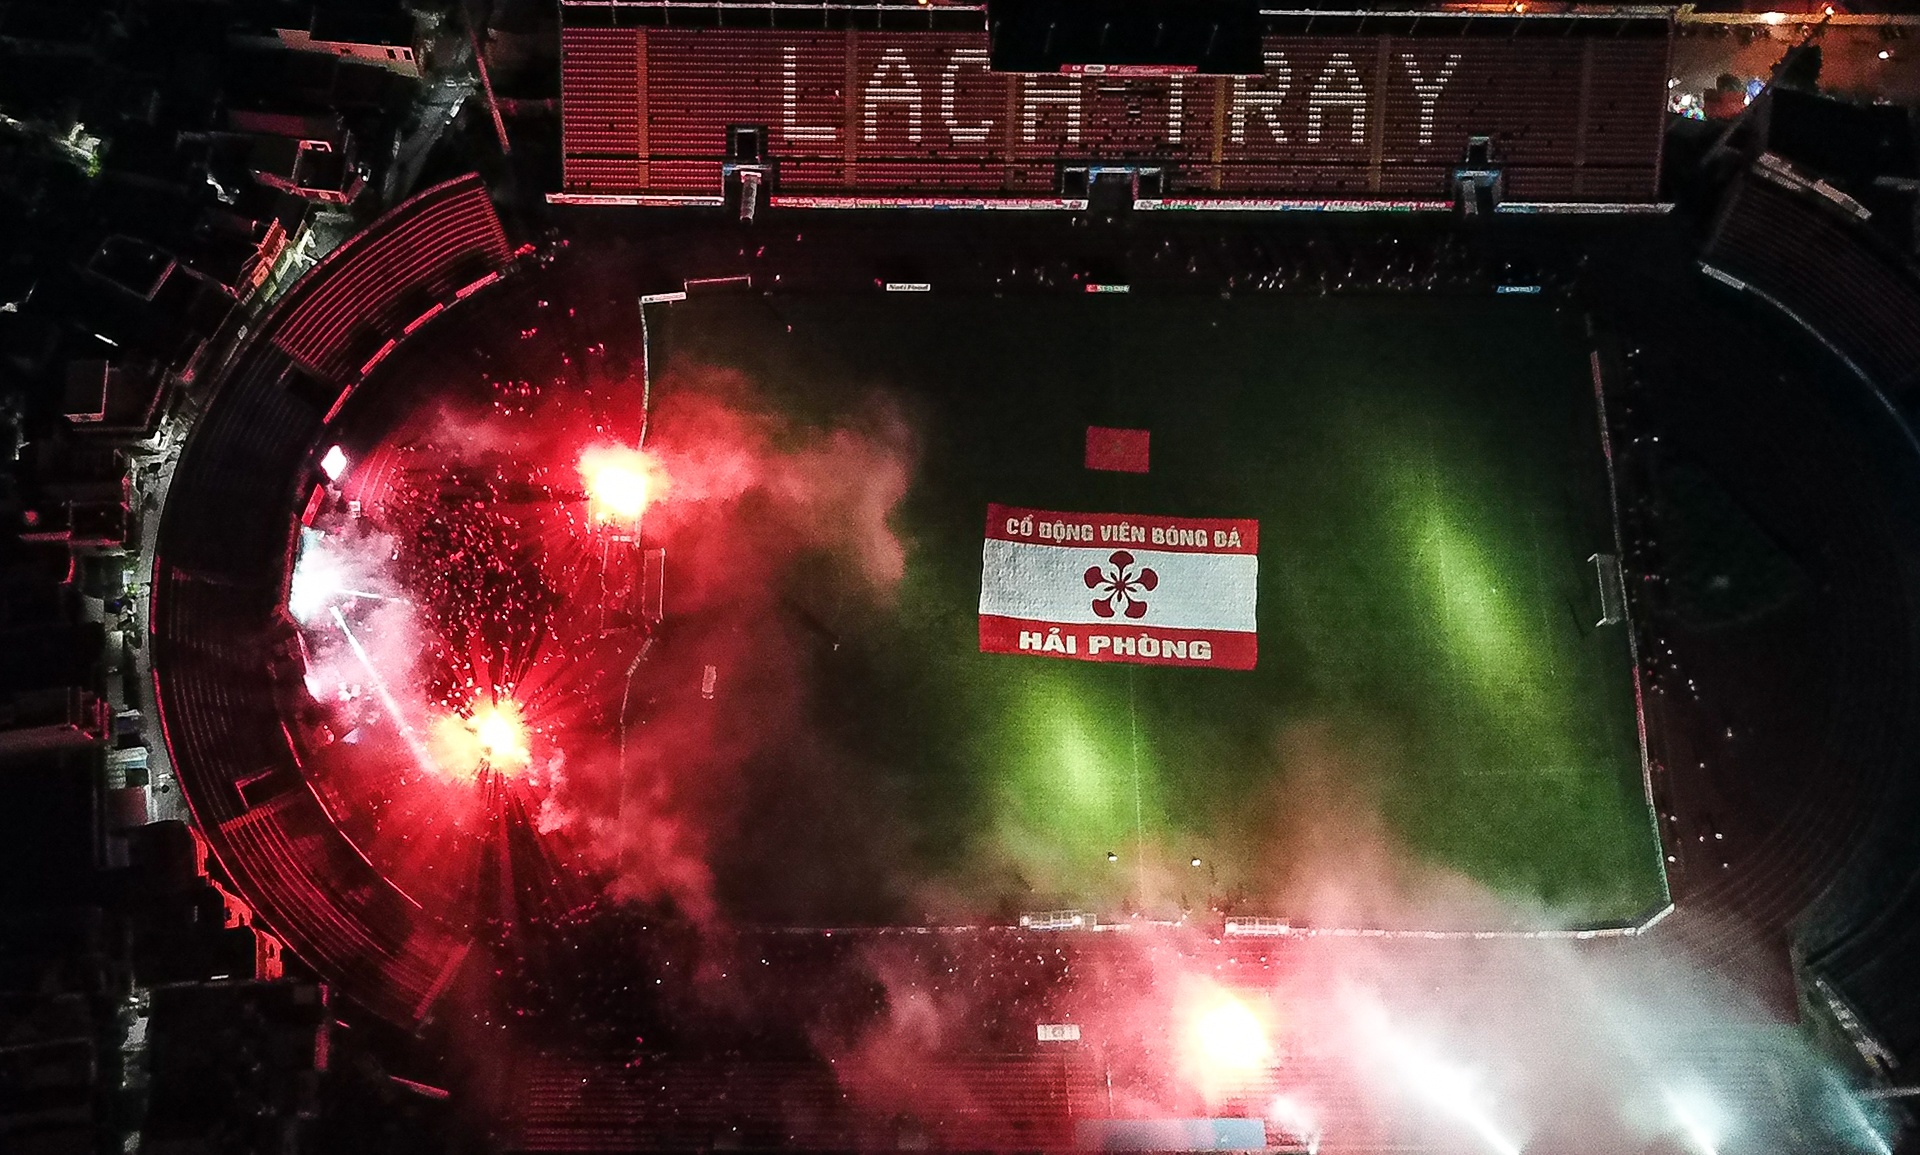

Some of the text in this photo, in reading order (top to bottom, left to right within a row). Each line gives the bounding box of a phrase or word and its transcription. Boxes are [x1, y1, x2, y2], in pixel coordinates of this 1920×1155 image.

[1038, 519, 1093, 543] ĐỘNG
[1099, 521, 1146, 543] VIÊN
[1152, 520, 1208, 547] BÓNG
[1214, 527, 1242, 548] ĐÁ
[1018, 627, 1212, 660] HẢI PHÒNG
